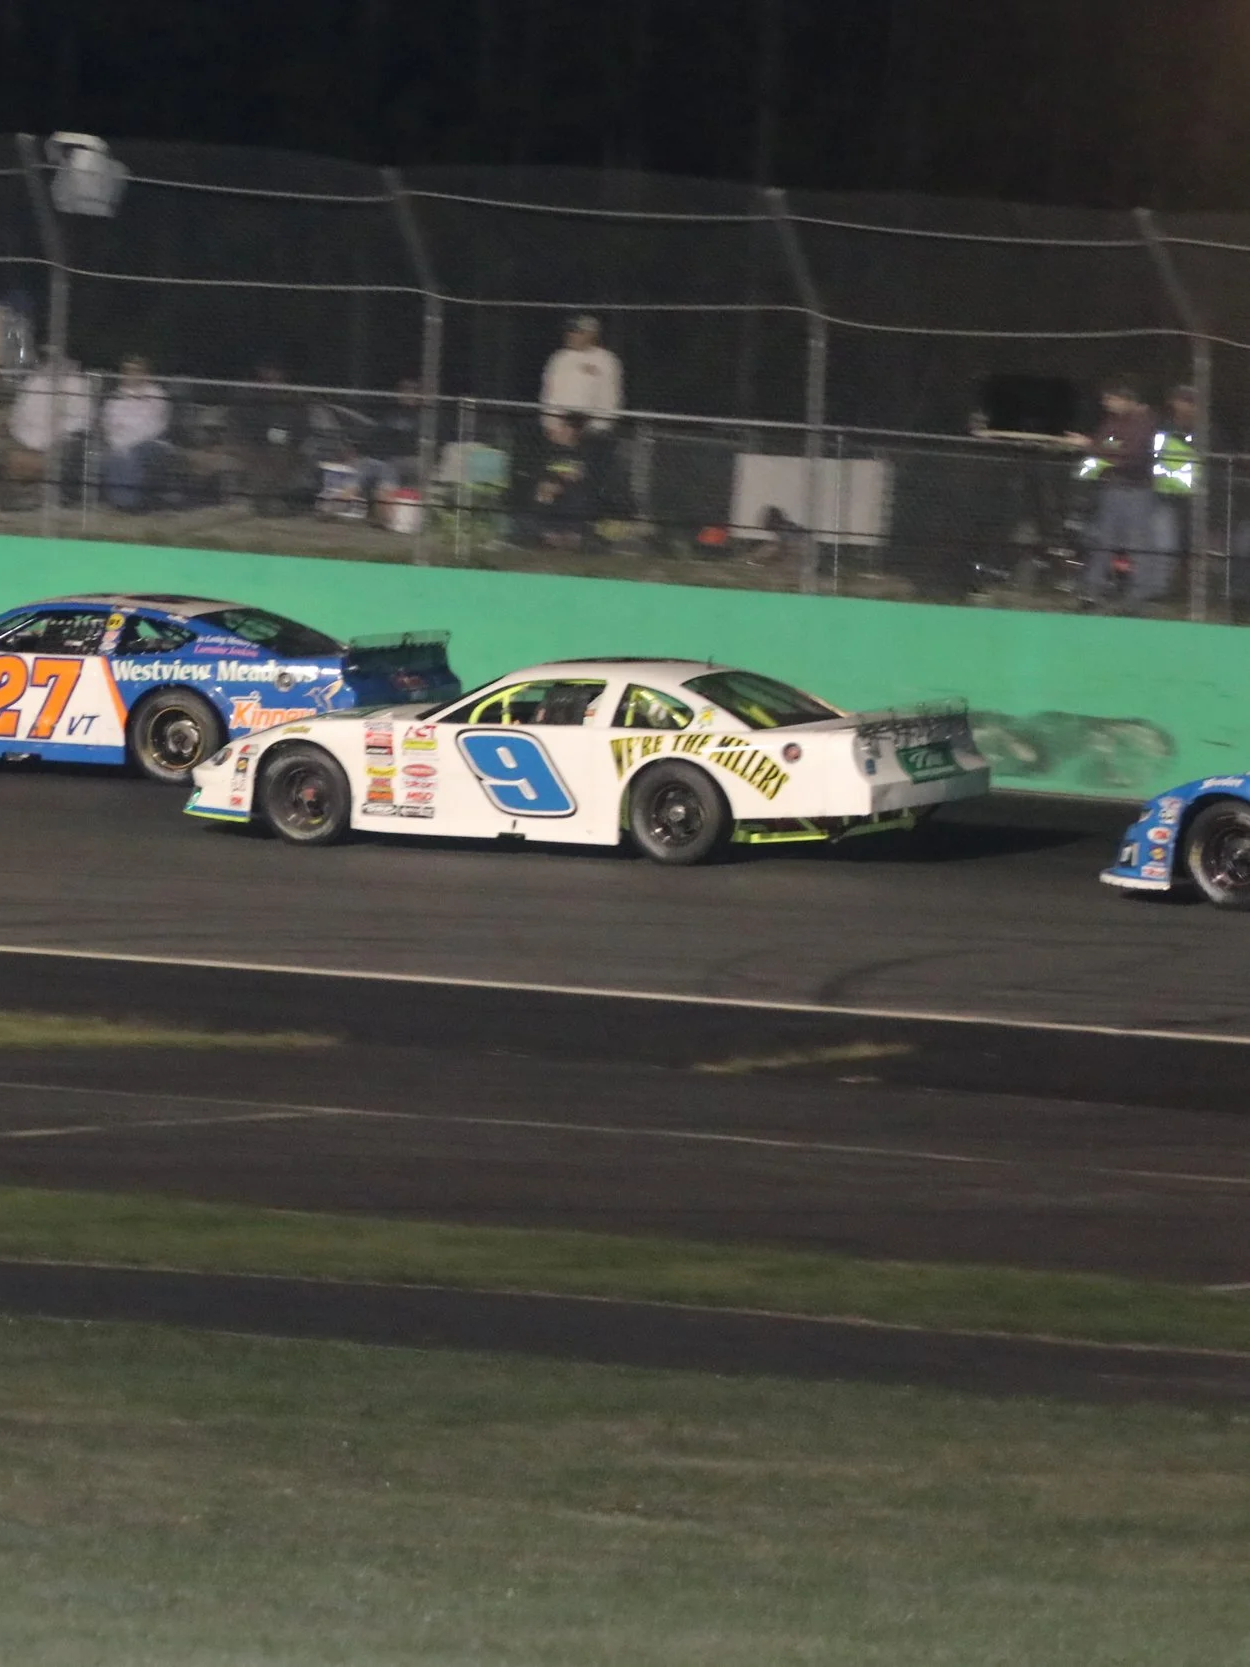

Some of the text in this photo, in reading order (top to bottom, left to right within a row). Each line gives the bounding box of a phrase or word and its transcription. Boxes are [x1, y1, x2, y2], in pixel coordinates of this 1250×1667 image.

[111, 659, 212, 681] Westview
[66, 715, 100, 736] VT
[457, 729, 576, 816] 9
[610, 734, 790, 800] WE'RE THE MILLERS
